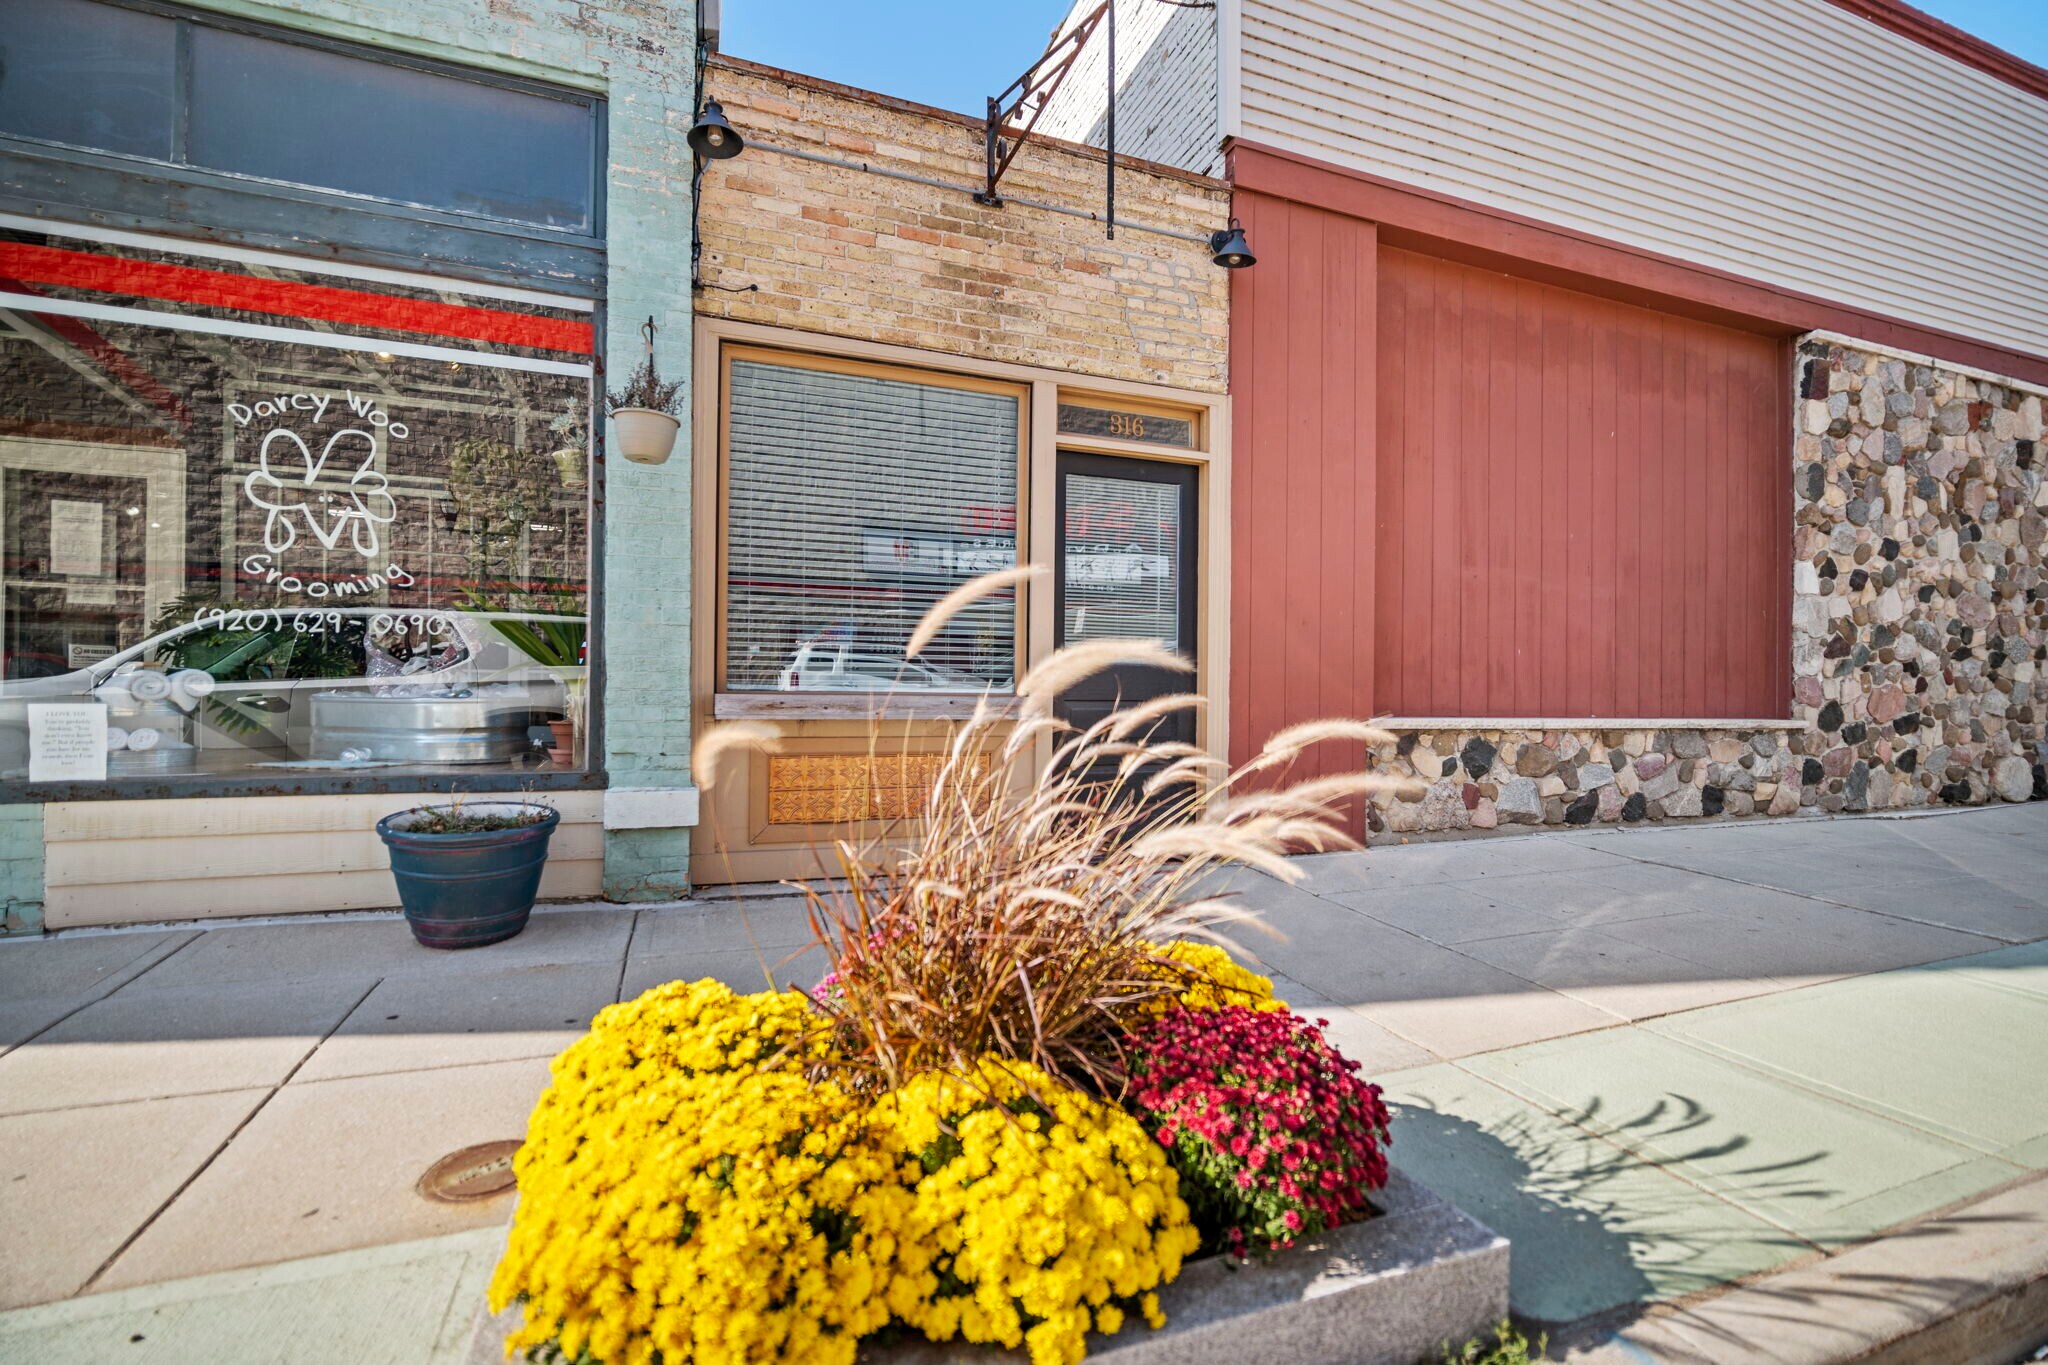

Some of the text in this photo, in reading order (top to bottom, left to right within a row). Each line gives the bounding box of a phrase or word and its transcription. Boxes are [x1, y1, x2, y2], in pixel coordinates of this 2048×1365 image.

[227, 389, 409, 439] Darcy Woo
[1110, 414, 1144, 437] 316
[243, 554, 415, 598] Grooming
[193, 606, 283, 633] (920)
